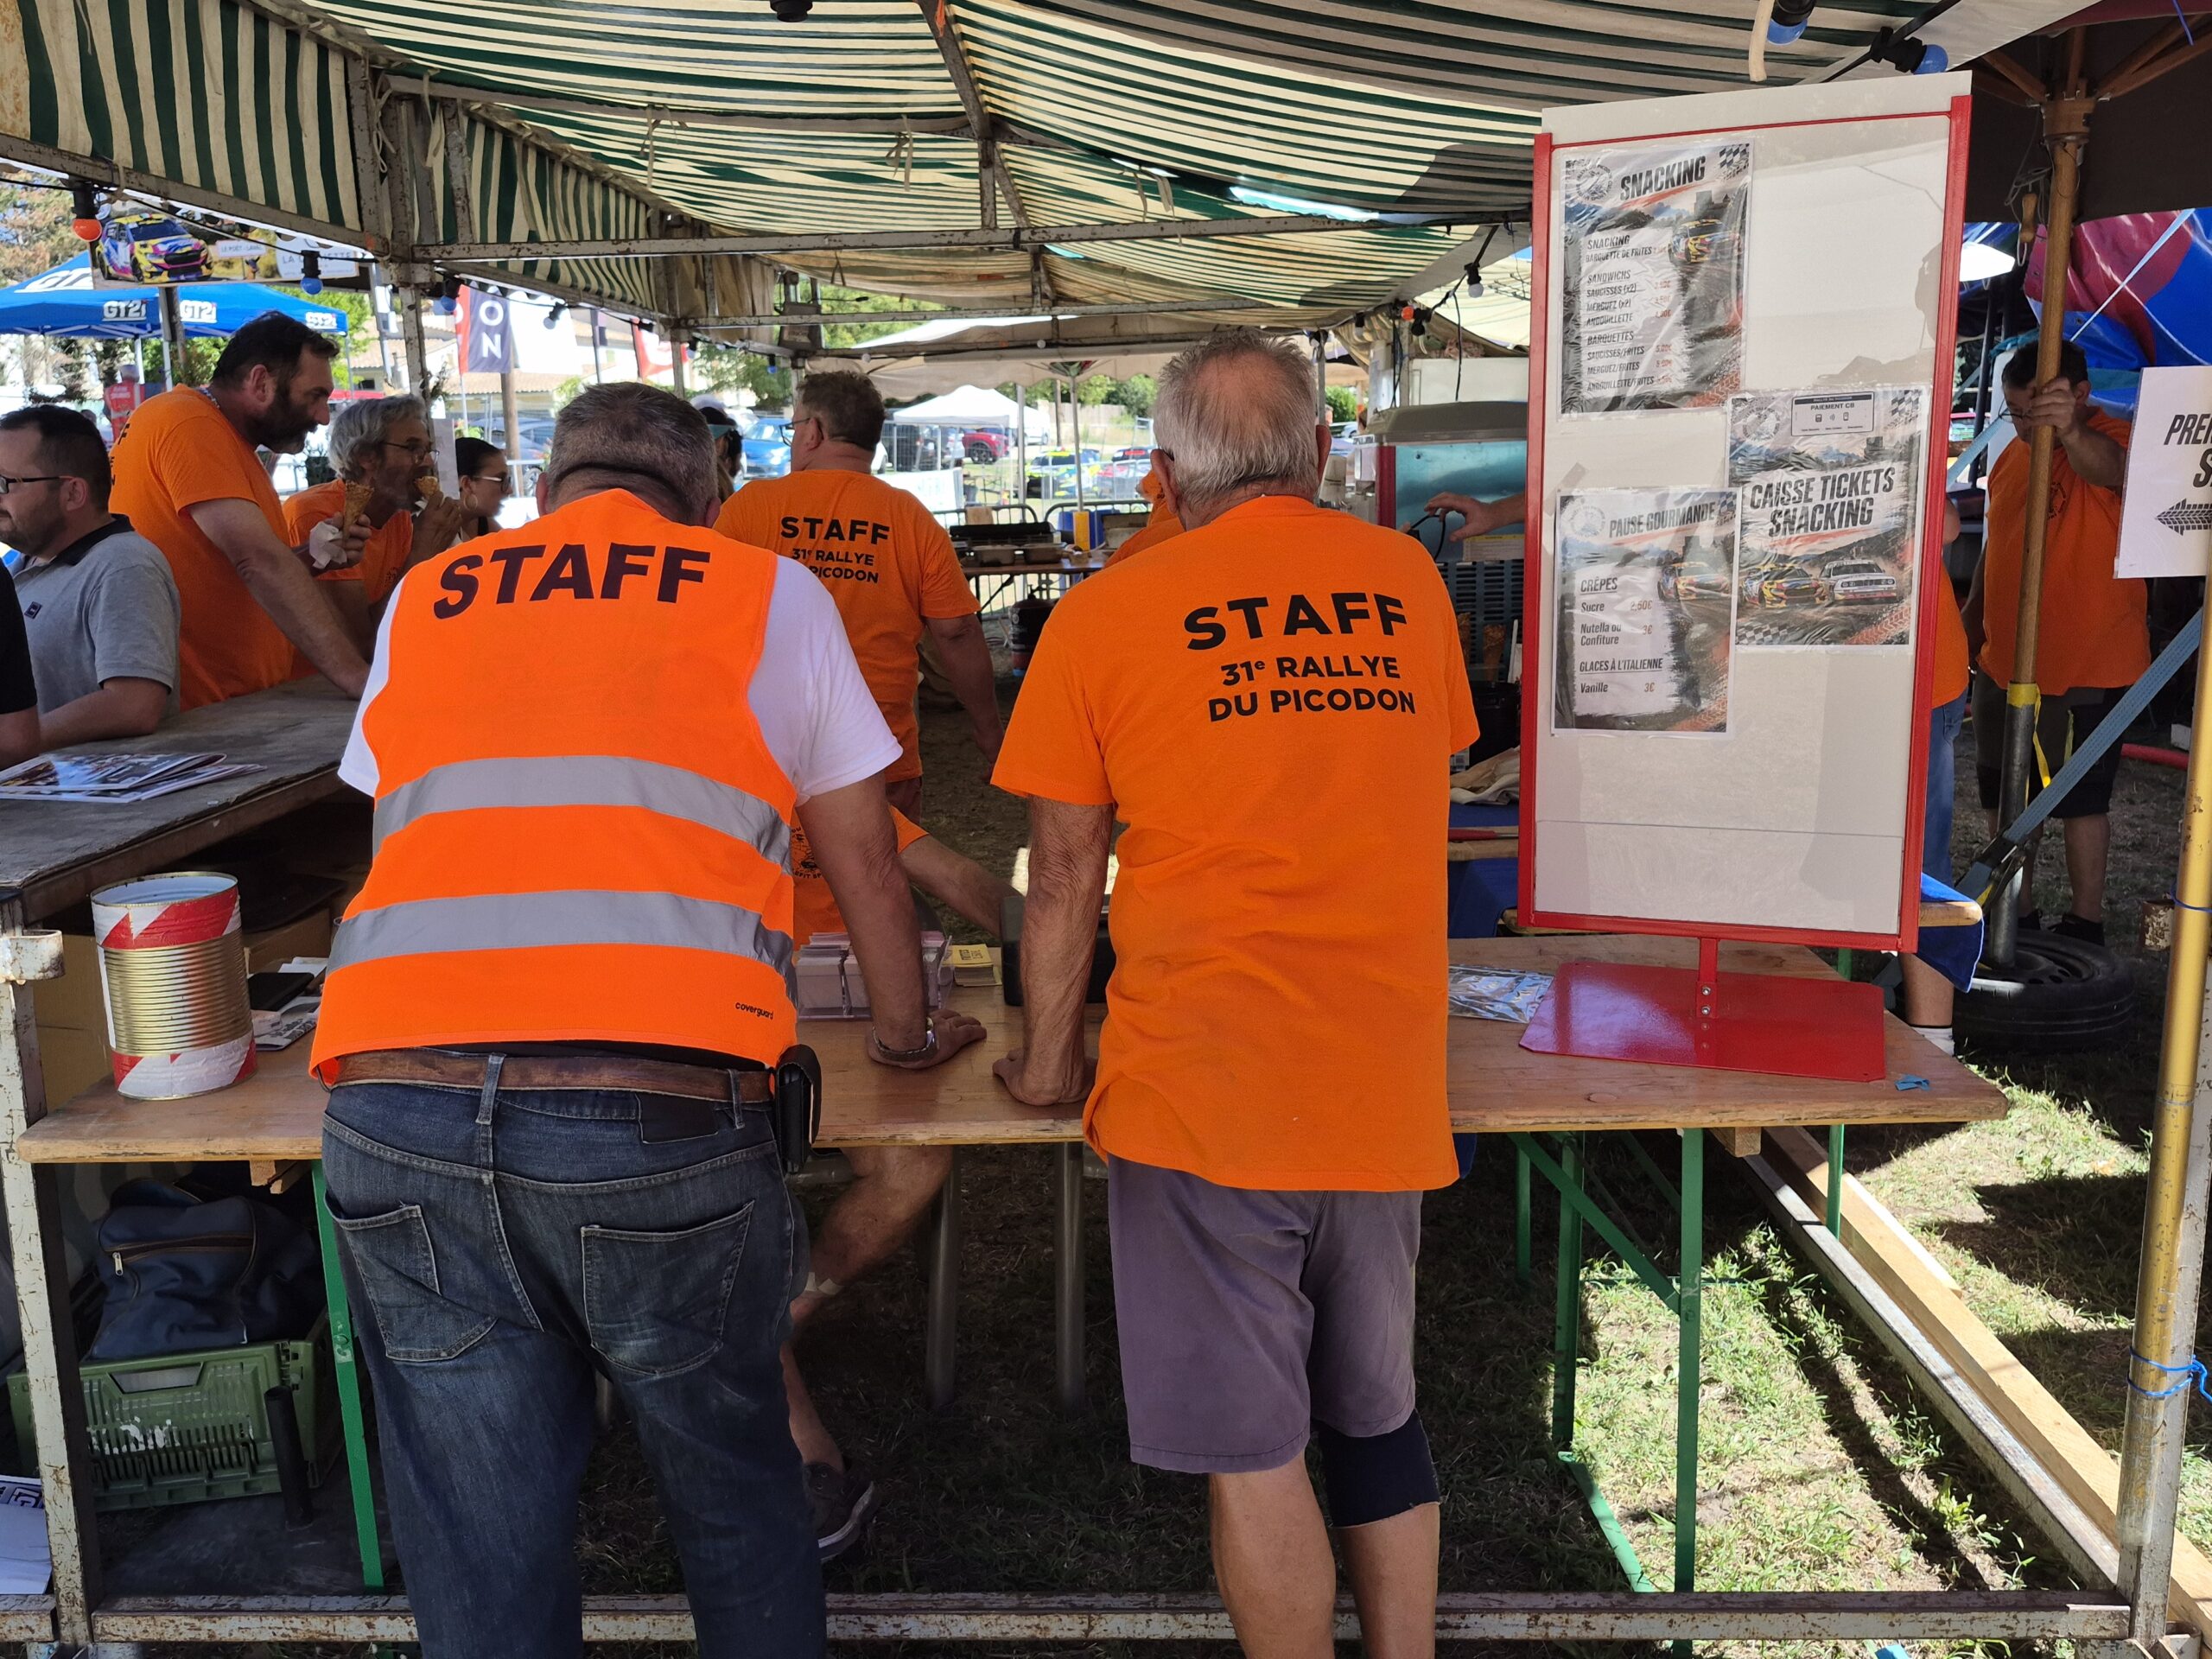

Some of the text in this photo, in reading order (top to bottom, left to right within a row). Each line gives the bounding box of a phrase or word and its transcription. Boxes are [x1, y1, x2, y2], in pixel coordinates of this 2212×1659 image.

[1620, 156, 1707, 201] SNACKING
[1587, 235, 1630, 250] SNACKING
[1586, 251, 1621, 263] BARQUETTE
[1622, 249, 1630, 258] DE
[1631, 246, 1652, 257] FRITES
[1587, 270, 1631, 283] SANDWICHS
[1586, 285, 1622, 297] SAUCISSES
[1586, 300, 1617, 311] MERGUEZ
[1586, 313, 1633, 326] ANDOUILLETTE
[1587, 331, 1634, 345] BARQUETTES
[1587, 346, 1645, 360] SAUCISSES/FRITES
[1587, 361, 1640, 374] MERGUEZ/FRITES
[1750, 467, 1896, 510] CAISSE TICKETS
[1609, 515, 1644, 537] PAUSE
[1646, 502, 1716, 531] GOURMANDE
[1769, 497, 1874, 537] SNACKING
[780, 517, 890, 545] STAFF
[815, 550, 875, 566] RALLYE
[434, 543, 711, 620] STAFF
[1580, 576, 1618, 593] CRÊPES
[1581, 601, 1605, 613] Sucre
[1183, 592, 1408, 651] STAFF
[1580, 622, 1610, 634] Nutella
[1611, 624, 1622, 632] ou
[1580, 634, 1619, 645] Confiture
[1275, 655, 1402, 679] RALLYE
[1580, 658, 1663, 672] GLACES À L'ITALIENNE
[1580, 682, 1609, 694] Vanille
[1208, 688, 1416, 722] DU PICODON
[735, 1002, 774, 1020] coverguard
